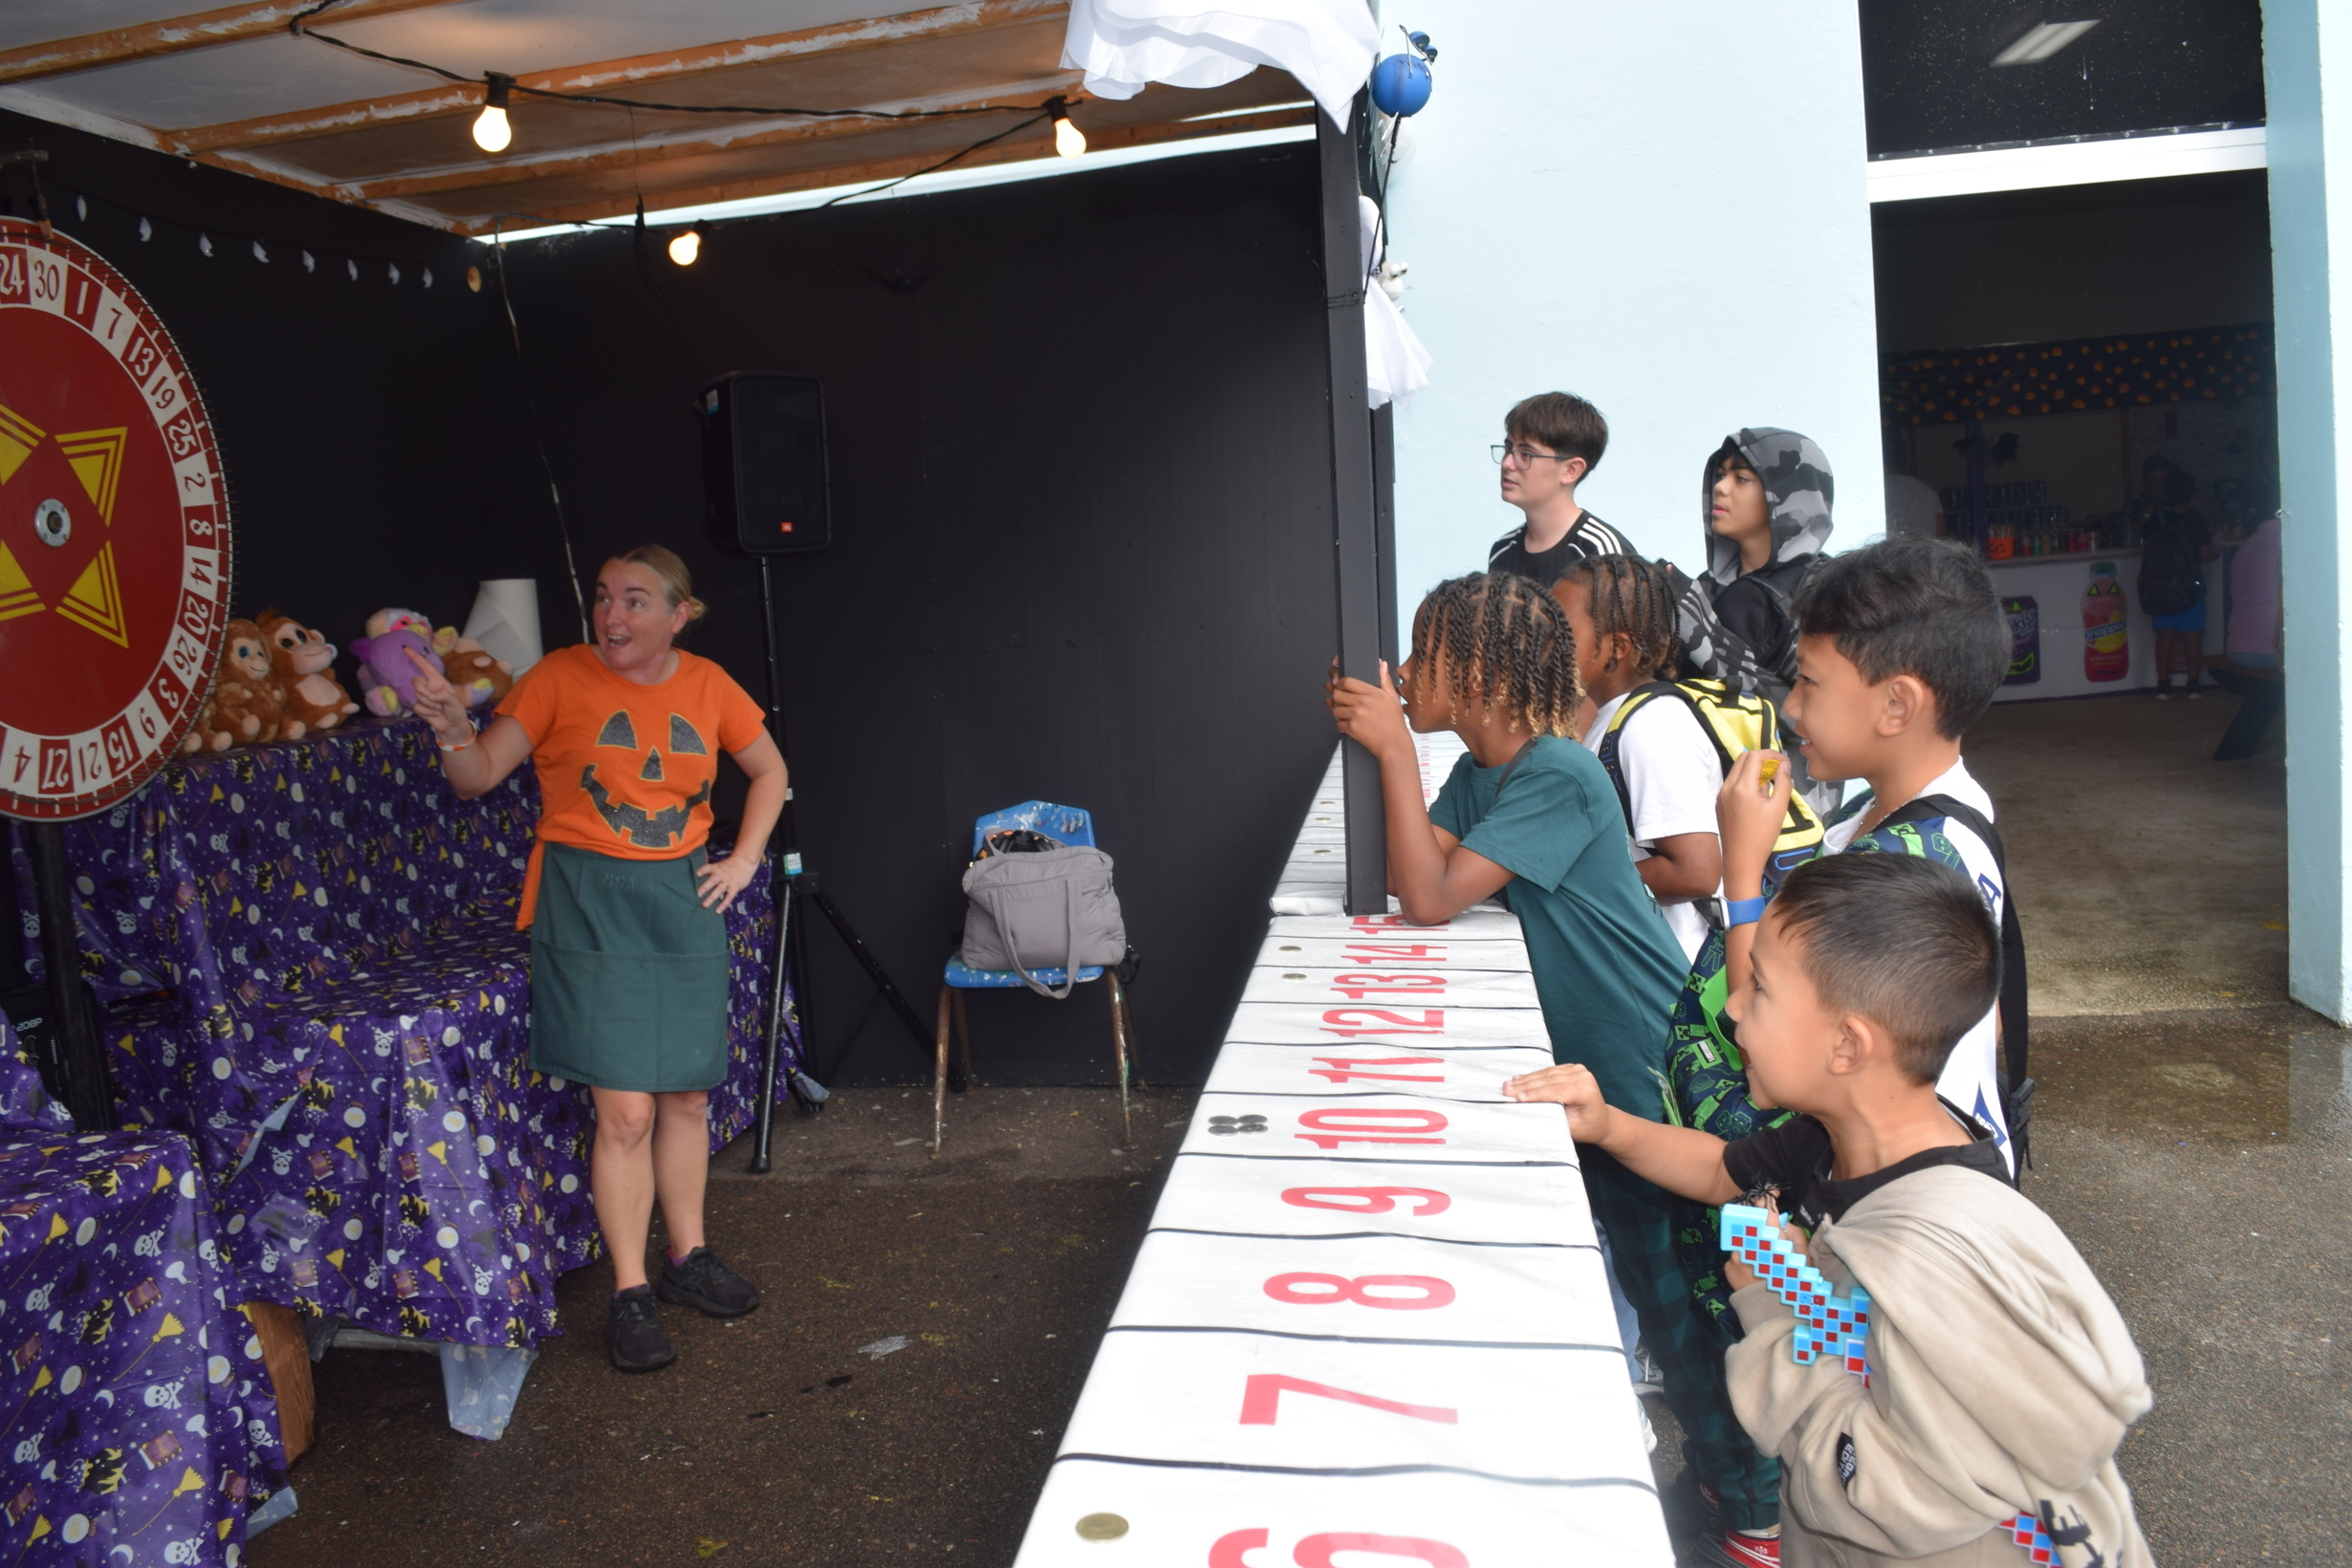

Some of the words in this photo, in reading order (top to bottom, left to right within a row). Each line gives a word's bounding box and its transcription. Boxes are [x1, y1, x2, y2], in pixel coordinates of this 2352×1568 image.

[0, 253, 25, 296] 24
[34, 260, 59, 301] 30
[76, 281, 89, 315] 1
[107, 307, 123, 339] 7
[128, 337, 155, 377] 13
[150, 376, 176, 409] 19
[168, 419, 198, 456] 25
[184, 472, 207, 492] 2
[189, 518, 213, 536] 8
[190, 556, 212, 587] 14
[184, 595, 210, 636] 20
[174, 634, 198, 675] 26
[158, 678, 180, 709] 3
[140, 708, 156, 740] 9
[11, 745, 33, 784] 4
[78, 741, 102, 784] 21
[107, 725, 135, 771] 15
[41, 747, 70, 791] 27
[1340, 943, 1448, 965] 14
[1330, 973, 1448, 1000] 13
[1319, 1009, 1445, 1038] 12
[1309, 1056, 1446, 1084] 11
[1295, 1107, 1449, 1150] 10
[1280, 1187, 1451, 1216] 9
[1263, 1272, 1456, 1311] 8
[1239, 1373, 1458, 1426] 7
